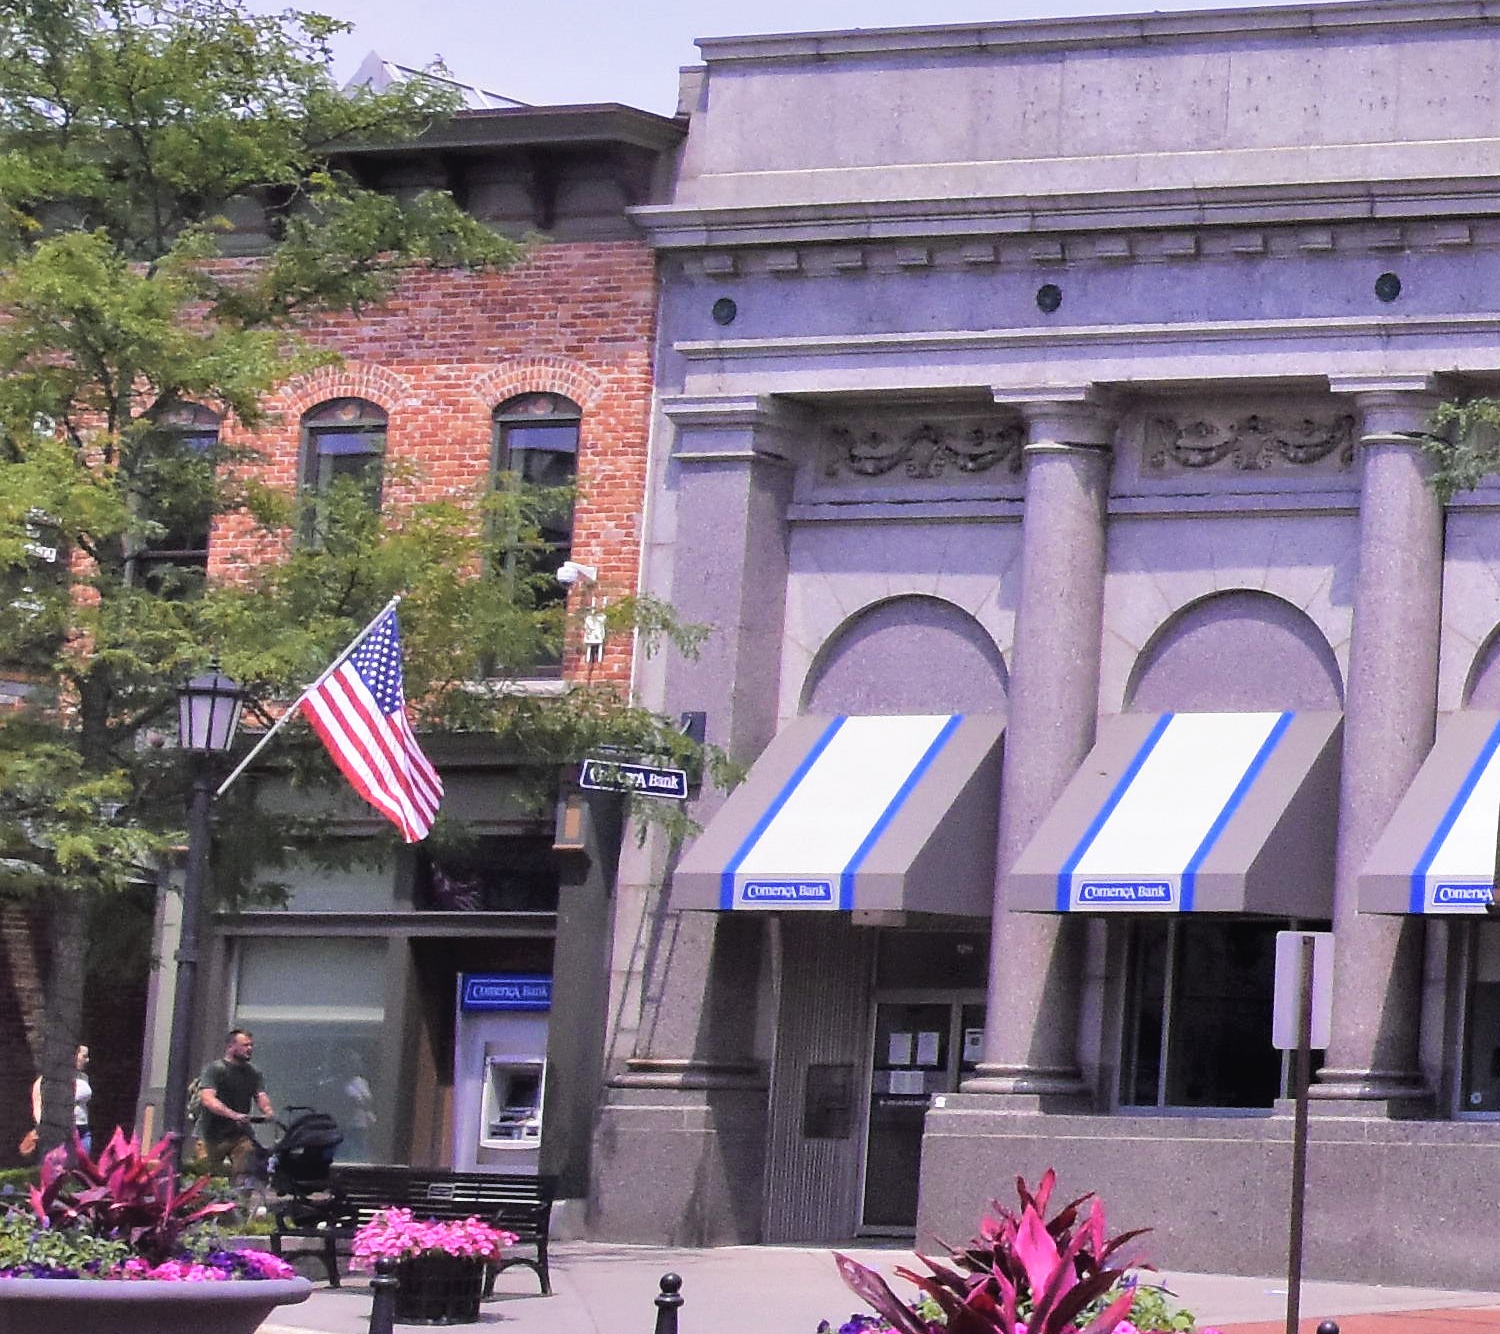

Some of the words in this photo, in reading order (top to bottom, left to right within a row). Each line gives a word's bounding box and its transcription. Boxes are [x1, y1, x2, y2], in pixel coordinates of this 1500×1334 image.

[649, 773, 679, 789] Bank
[799, 885, 826, 897] Bank
[1137, 885, 1165, 897] Bank
[523, 985, 548, 997] Bank
